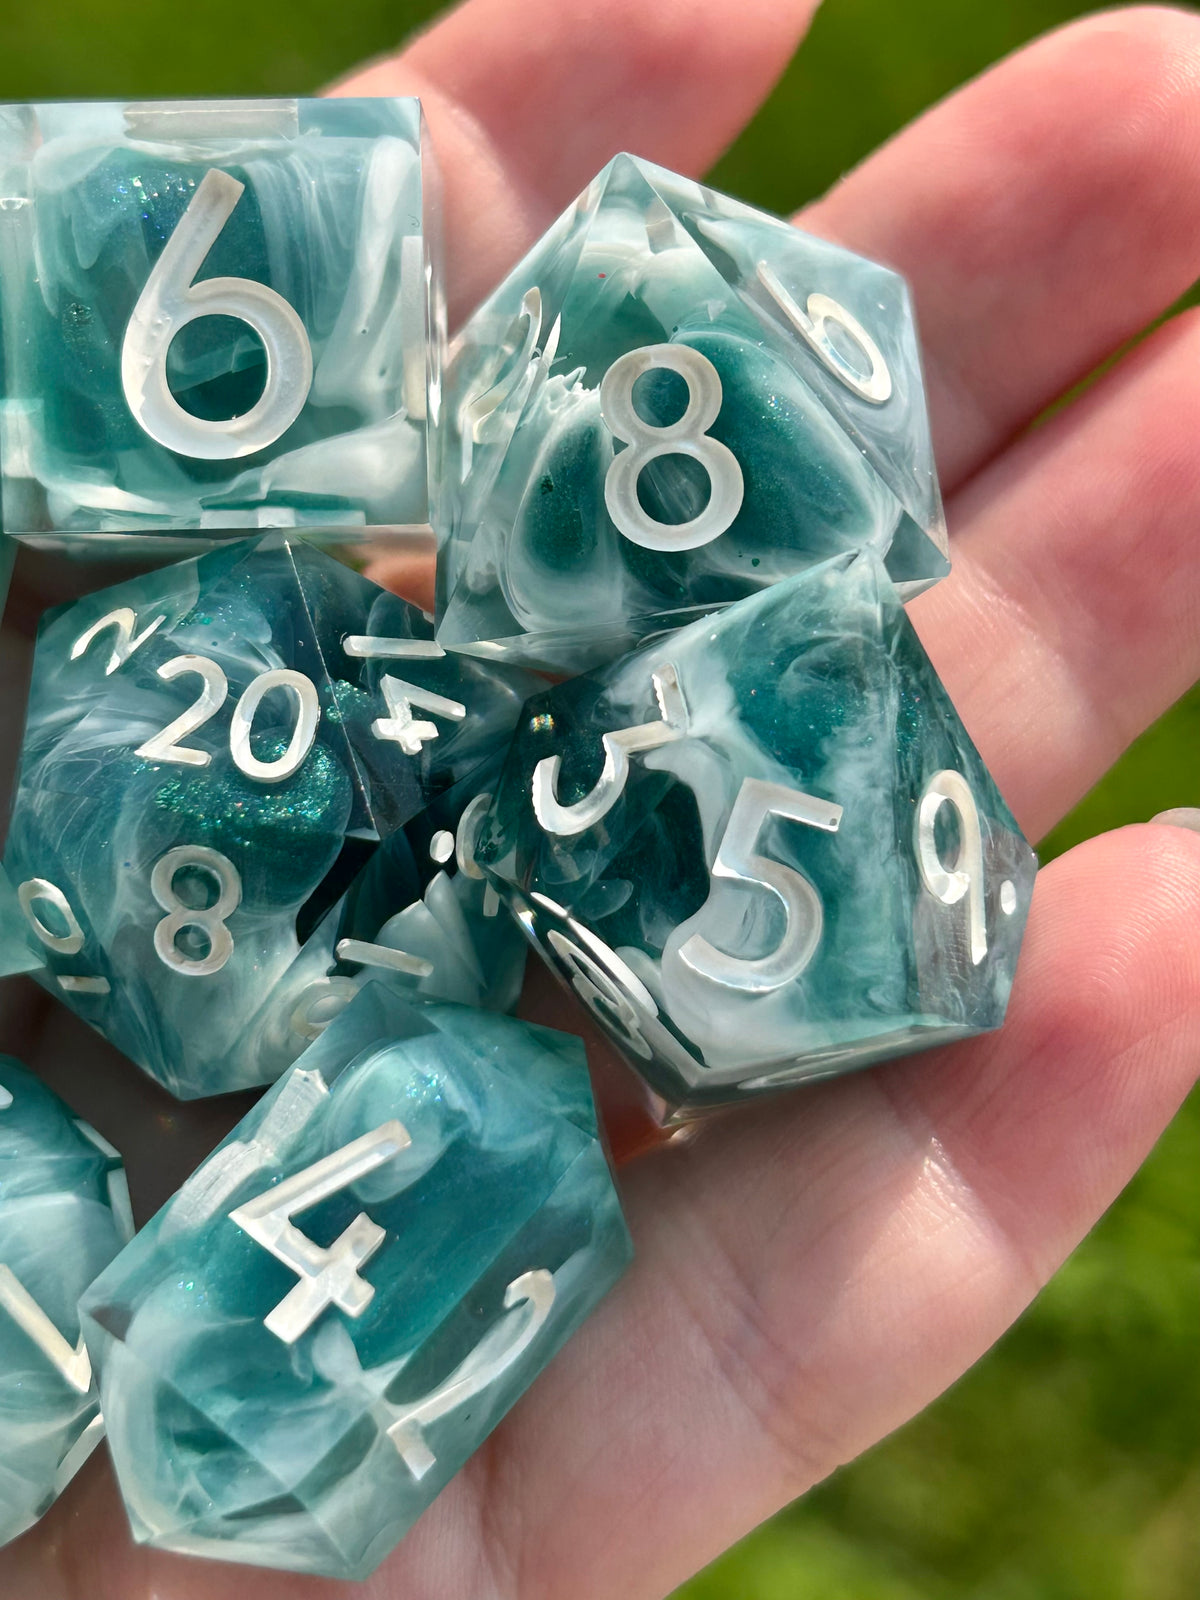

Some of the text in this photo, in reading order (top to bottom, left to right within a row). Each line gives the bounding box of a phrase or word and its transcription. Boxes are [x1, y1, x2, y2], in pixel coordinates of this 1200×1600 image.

[122, 168, 313, 460] 6
[757, 260, 893, 404] 6
[600, 343, 744, 552] 8
[70, 607, 167, 676] 2
[134, 654, 321, 784] 20
[151, 845, 243, 976] 8
[678, 778, 843, 993] 5
[228, 1119, 412, 1343] 4
[385, 1269, 556, 1481] 2
